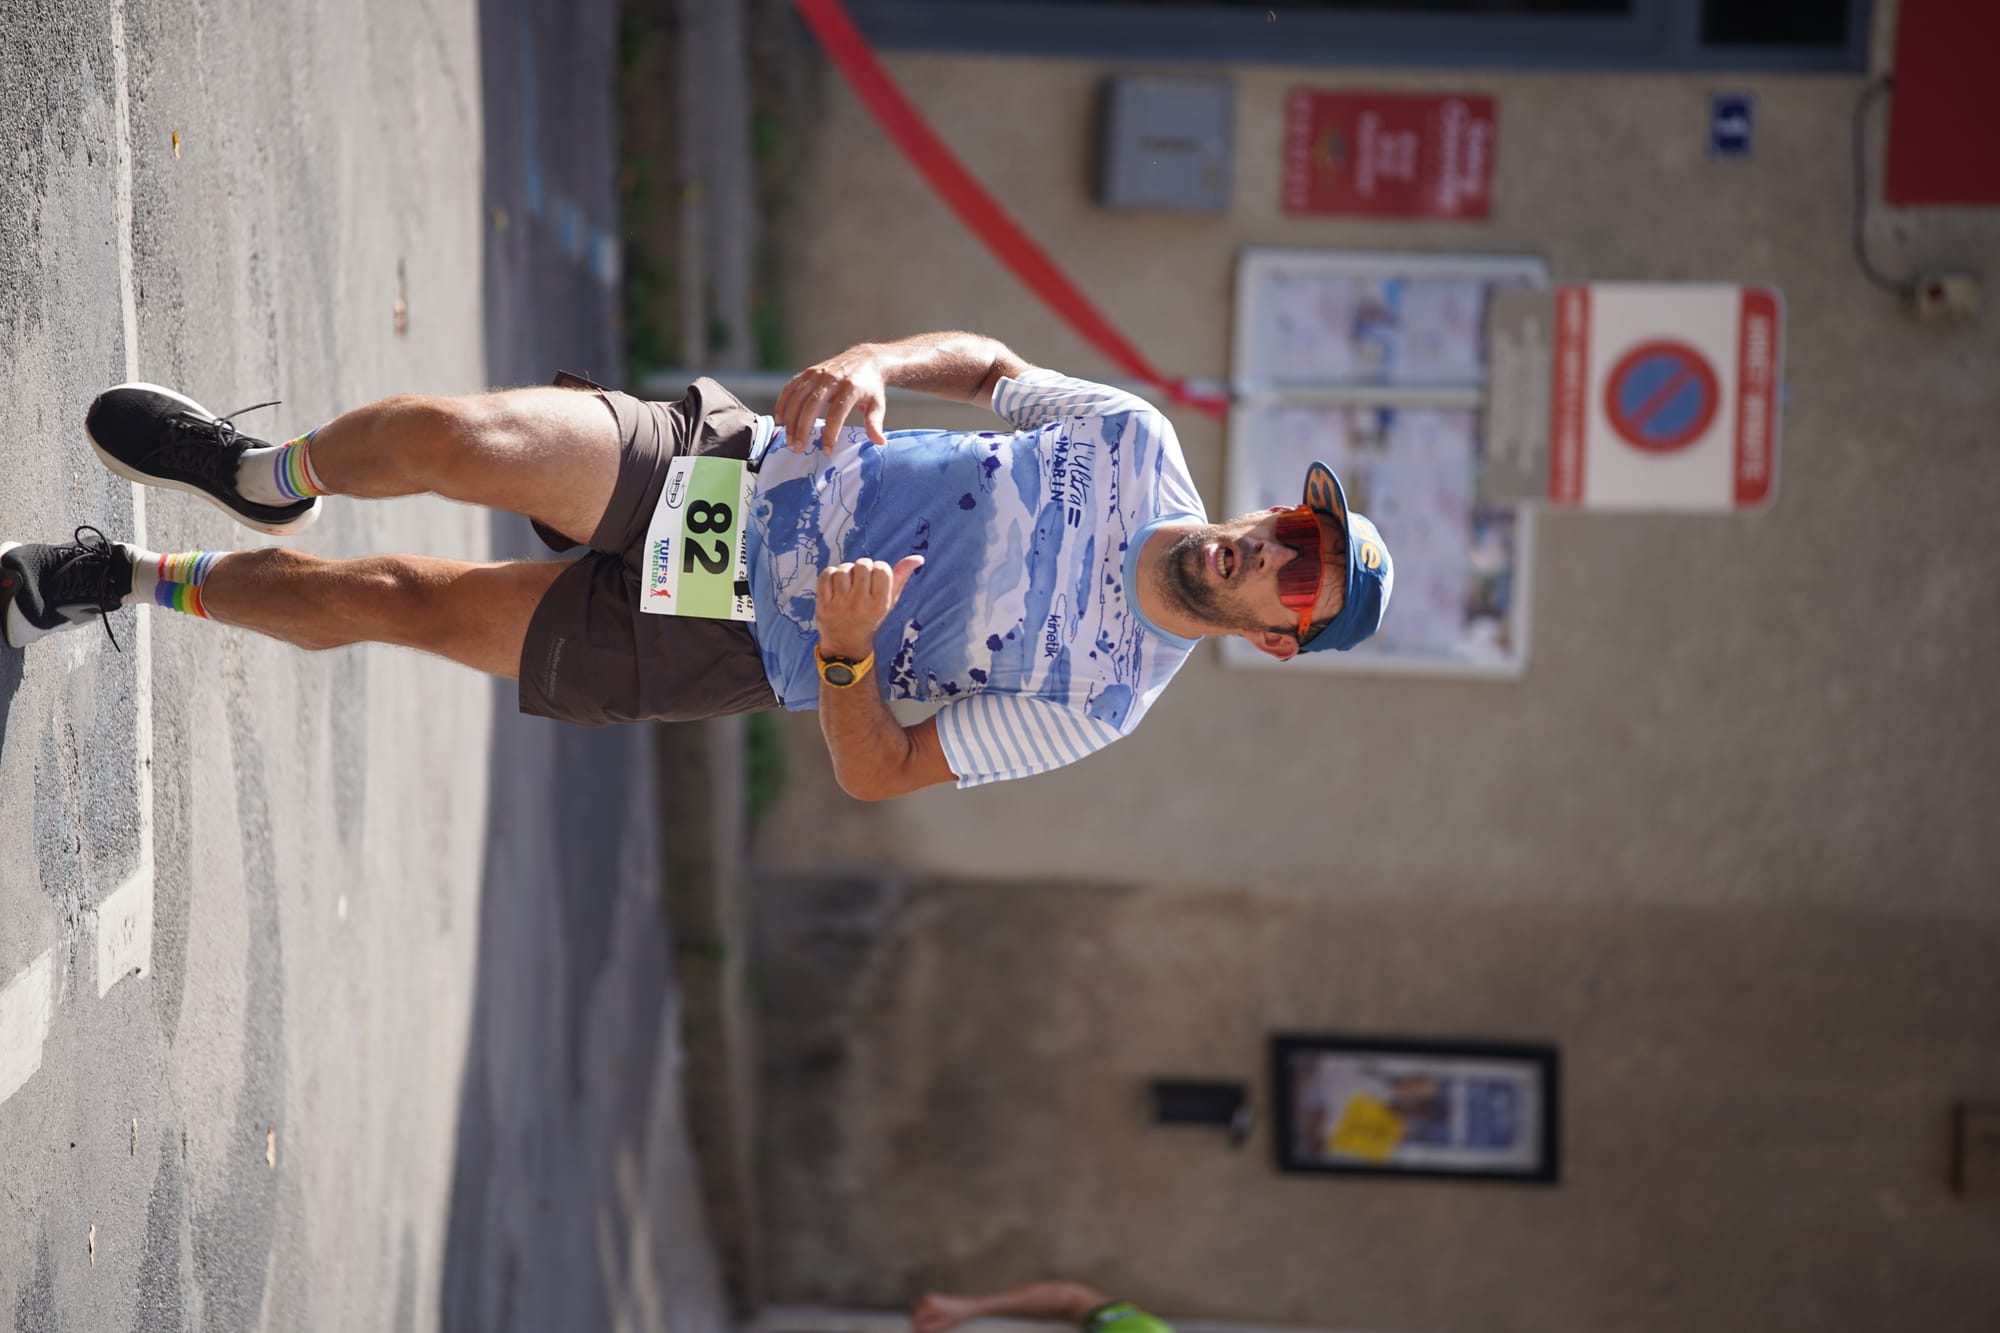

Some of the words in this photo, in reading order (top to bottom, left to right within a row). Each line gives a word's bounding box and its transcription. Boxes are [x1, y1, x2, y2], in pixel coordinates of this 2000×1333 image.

[669, 471, 684, 503] BFP
[1051, 441, 1069, 502] MARIN
[658, 537, 670, 584] TUFF'S
[683, 499, 733, 575] 82
[650, 541, 663, 588] Aventure
[1044, 615, 1062, 658] kinetik
